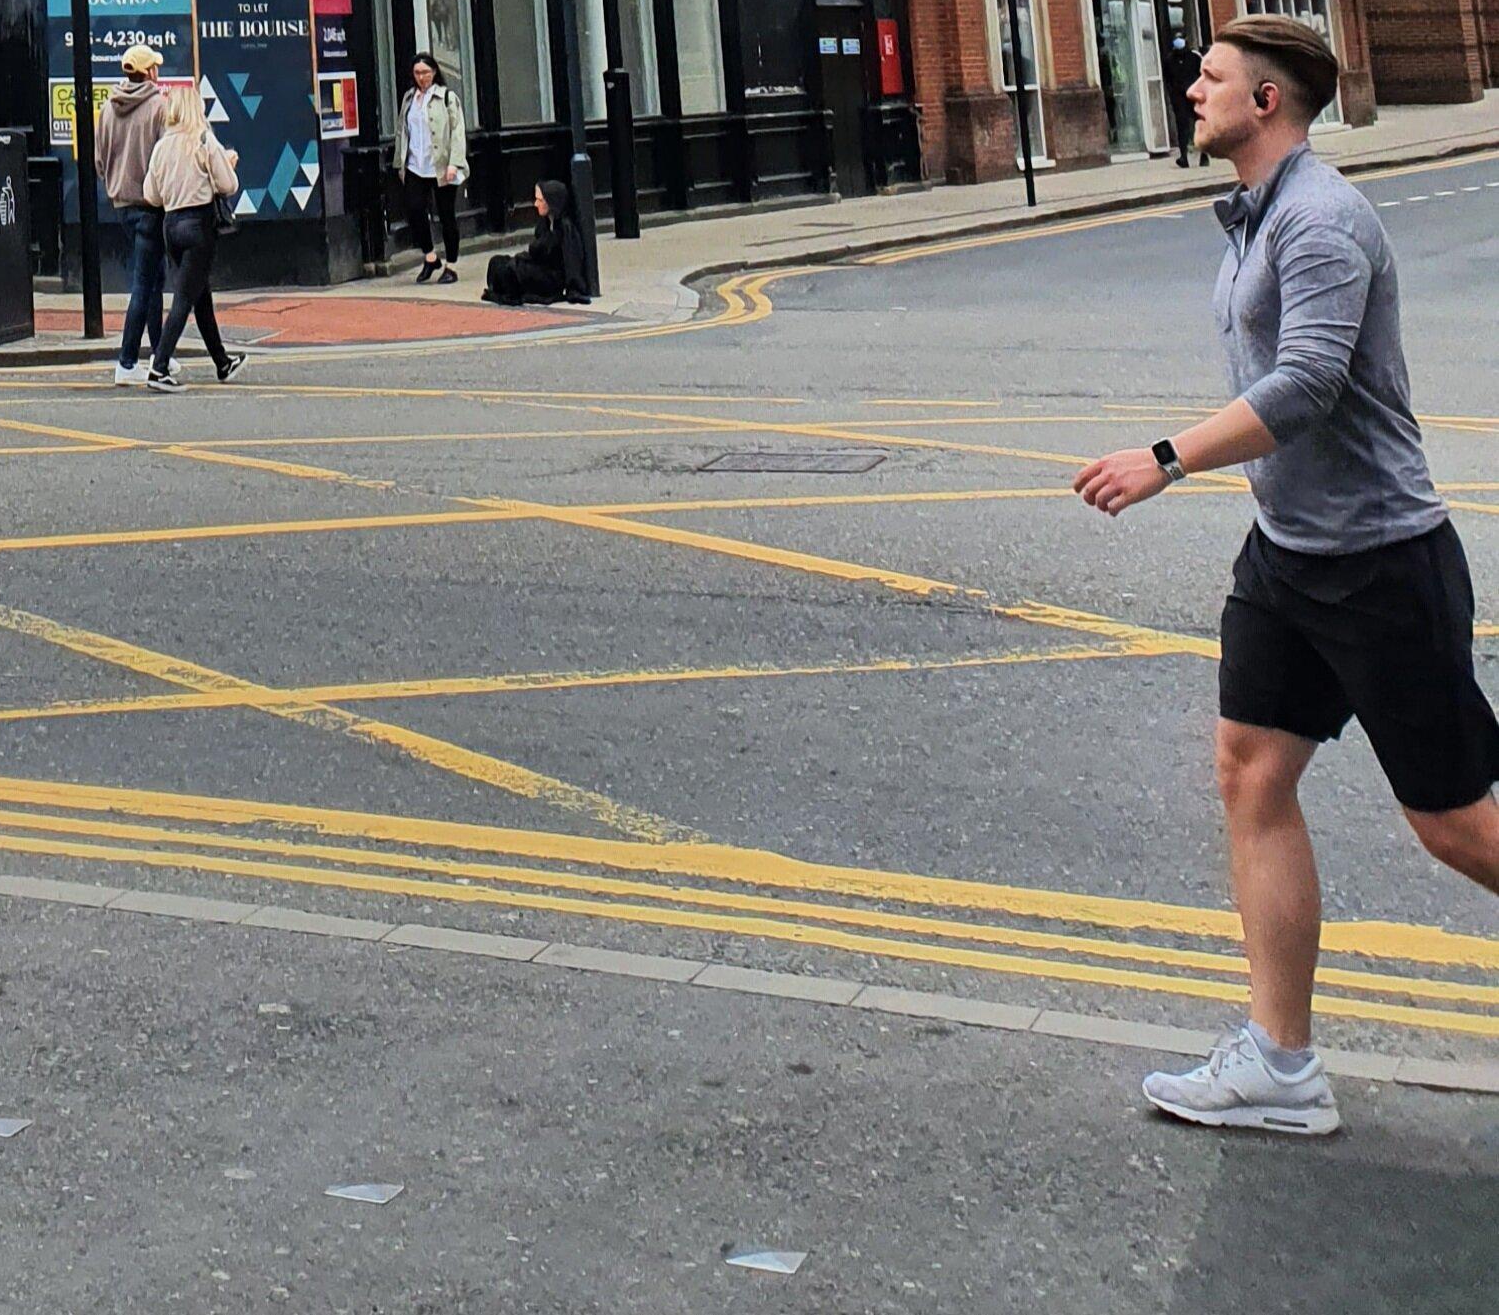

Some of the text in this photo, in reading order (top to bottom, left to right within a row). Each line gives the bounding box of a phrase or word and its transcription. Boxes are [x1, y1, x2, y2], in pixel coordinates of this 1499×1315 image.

[238, 2, 269, 13] TO LET
[199, 20, 235, 38] THE
[239, 18, 310, 38] BOURSE
[103, 30, 146, 48] 4,230
[147, 34, 163, 48] sq
[164, 30, 177, 45] ft
